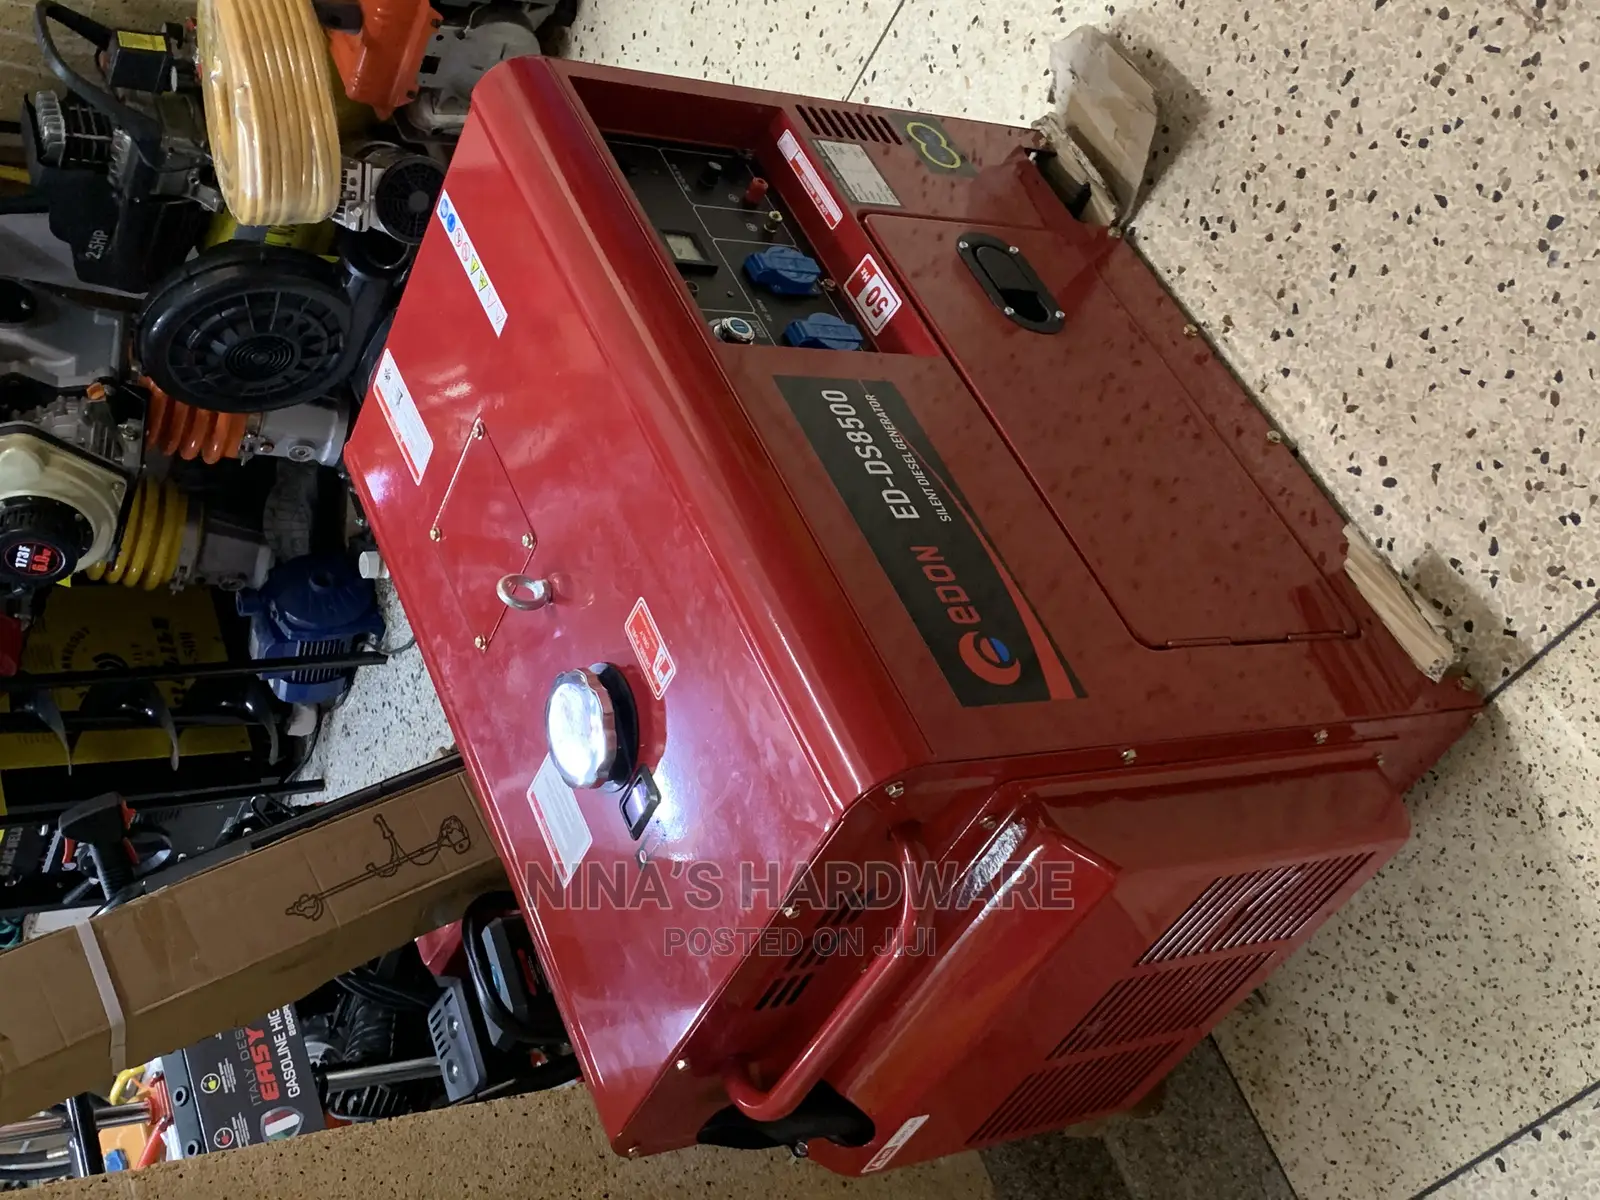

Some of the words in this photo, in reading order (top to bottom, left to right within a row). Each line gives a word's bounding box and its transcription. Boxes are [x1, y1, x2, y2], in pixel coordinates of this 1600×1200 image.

[85, 230, 108, 259] 2.5HP
[865, 286, 889, 318] 50
[865, 394, 907, 450] GENERATOR
[821, 390, 920, 519] ED-DS8500
[901, 452, 930, 486] DIESEL
[922, 487, 952, 522] SILENT
[15, 545, 30, 568] 173F
[245, 1027, 280, 1101] EASY
[273, 1032, 301, 1098] GASOLINE
[244, 1068, 262, 1106] ITALY
